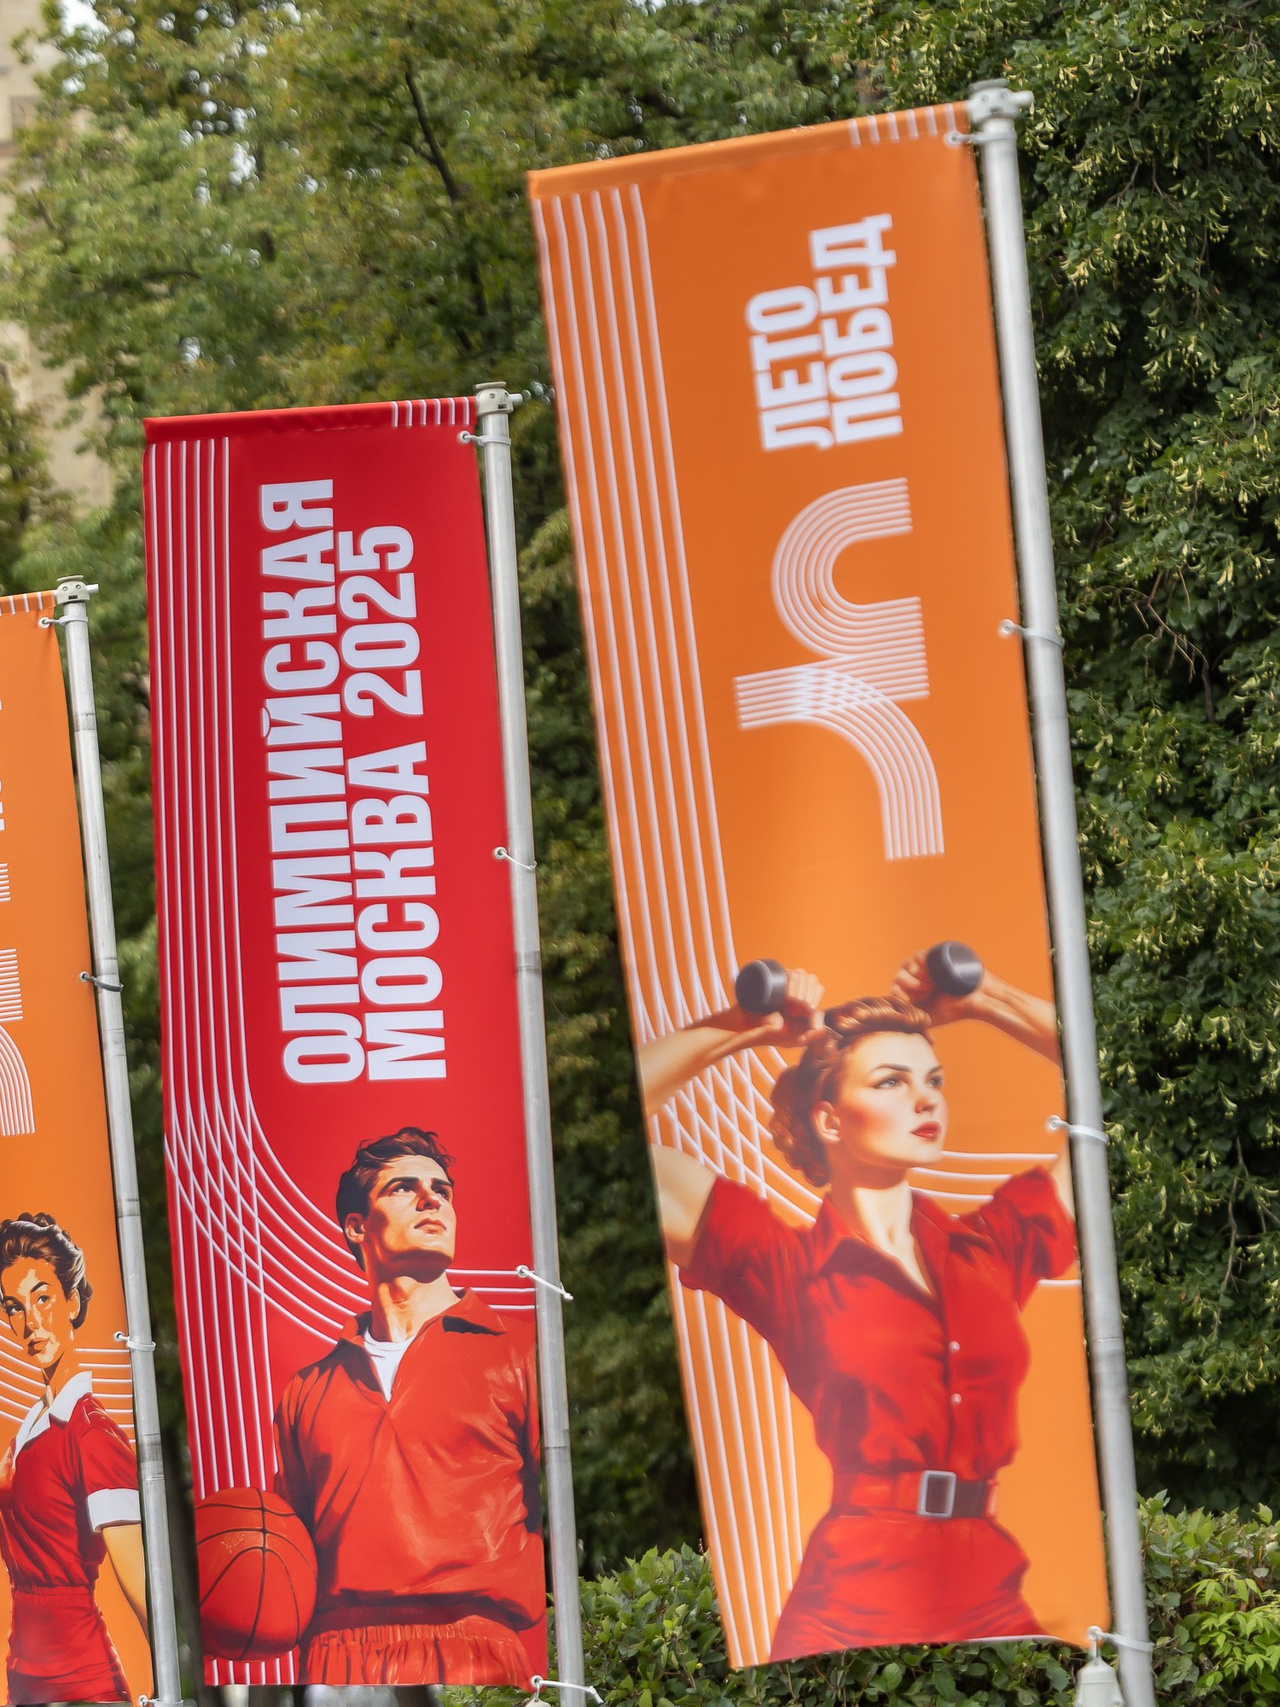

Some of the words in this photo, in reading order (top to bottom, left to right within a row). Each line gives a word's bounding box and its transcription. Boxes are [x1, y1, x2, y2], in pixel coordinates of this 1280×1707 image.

[744, 285, 833, 451] ЛЕТО
[809, 213, 897, 445] ПОБЕД
[337, 525, 424, 717] 2025
[260, 478, 366, 1085] ОЛИМПИЙСКАЯ
[344, 741, 447, 1082] МОСКВА
